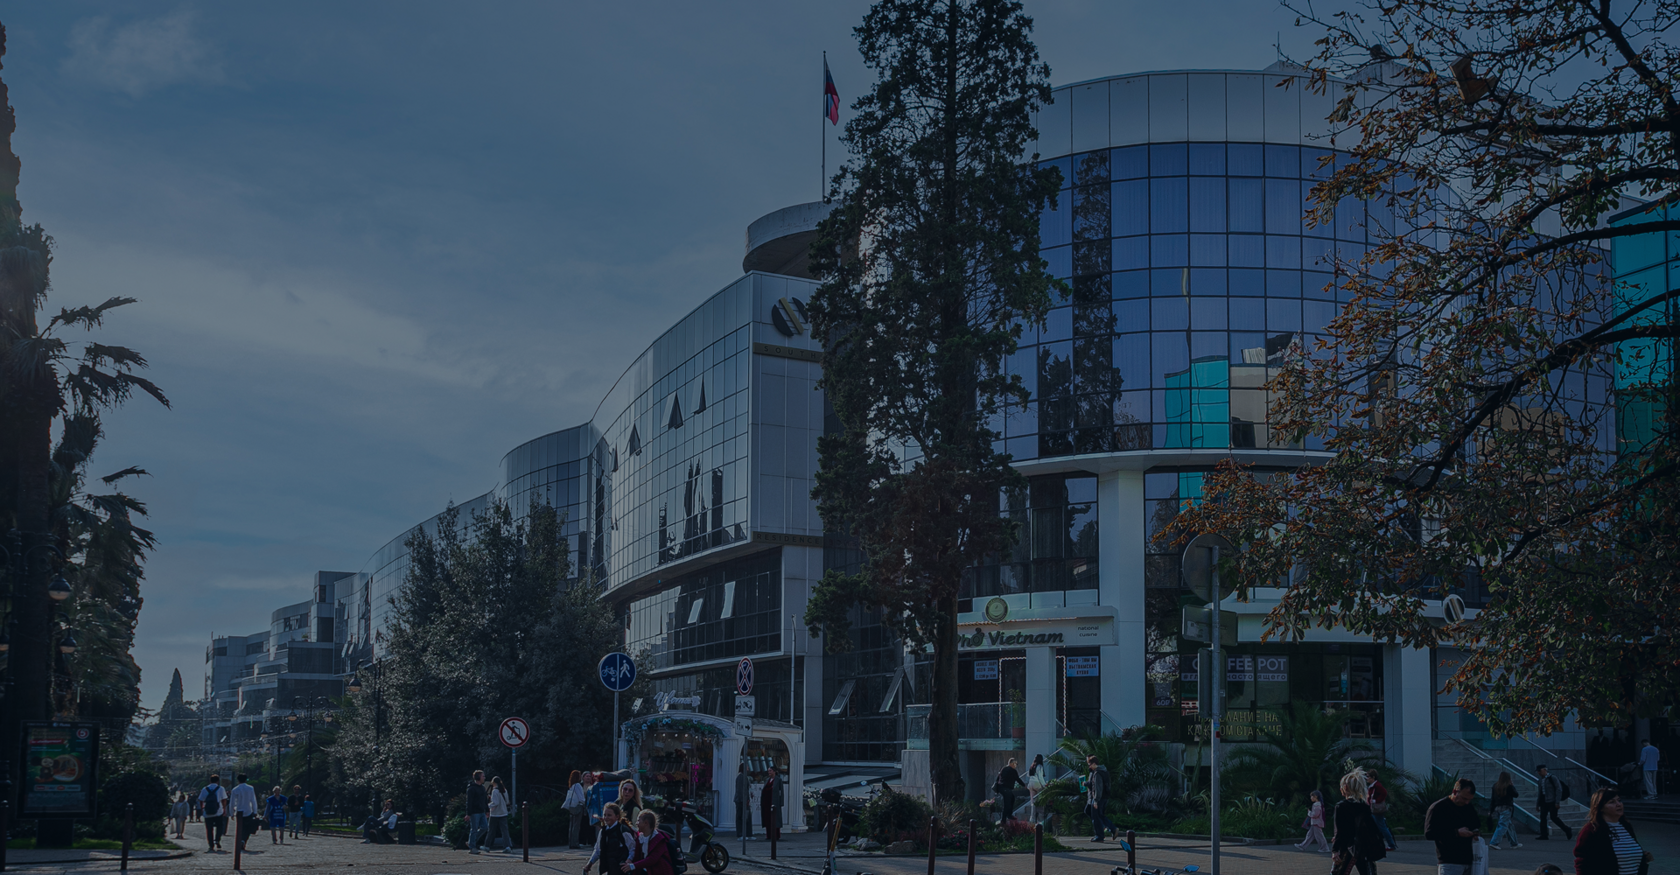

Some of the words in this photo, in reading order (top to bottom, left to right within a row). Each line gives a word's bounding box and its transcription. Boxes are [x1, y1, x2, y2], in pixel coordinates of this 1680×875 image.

[764, 345, 817, 359] SOUTH
[756, 533, 820, 544] RESIDENCE
[988, 630, 1064, 647] Vietnam
[1258, 658, 1287, 671] POT
